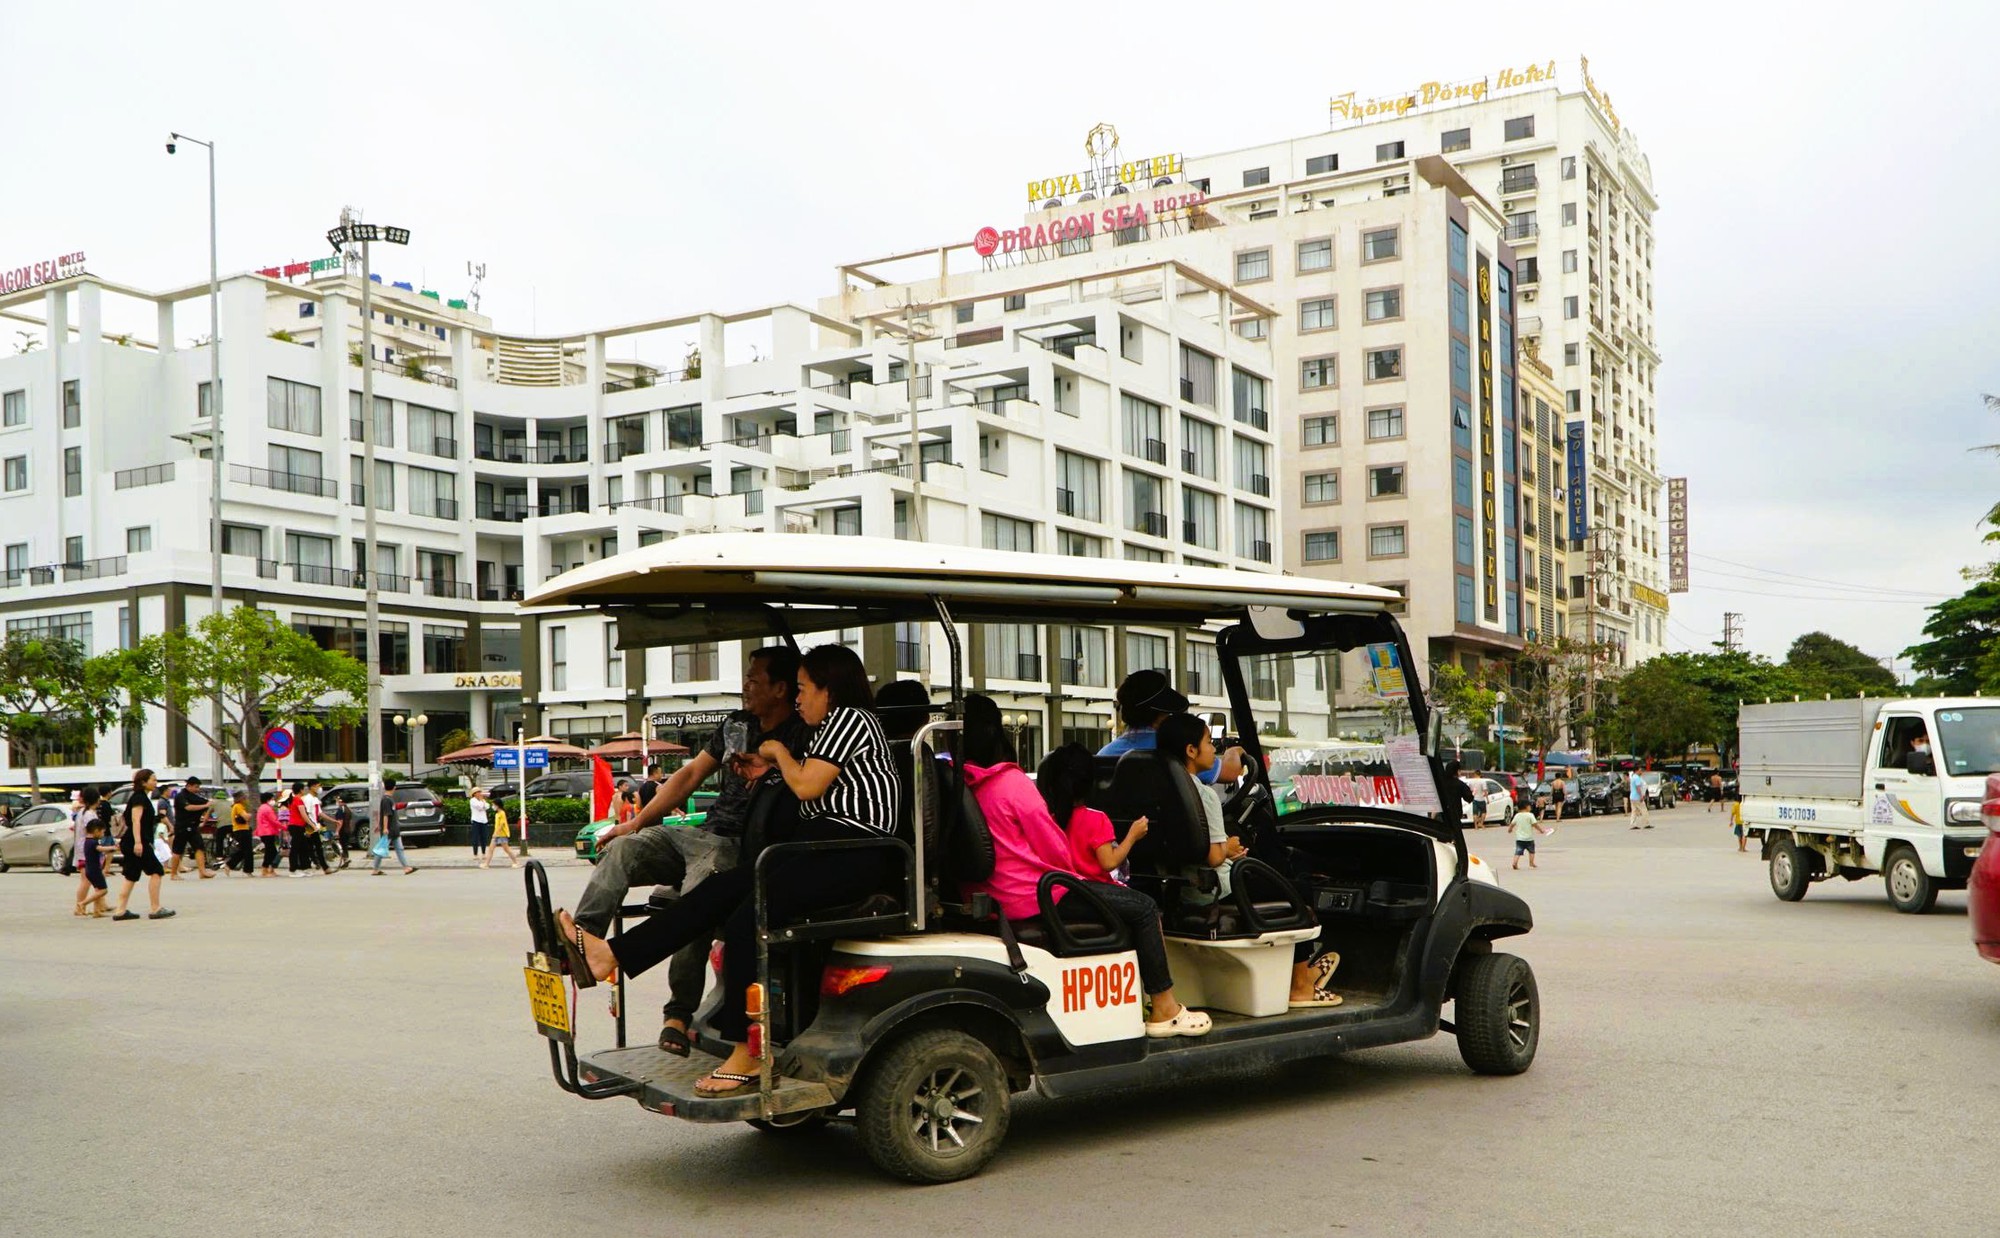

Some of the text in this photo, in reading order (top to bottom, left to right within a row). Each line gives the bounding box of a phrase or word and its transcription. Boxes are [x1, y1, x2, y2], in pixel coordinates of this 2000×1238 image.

[1496, 59, 1555, 89] Hotel
[1027, 153, 1183, 202] ROYAL HOTEL
[1002, 190, 1208, 253] DRAGON SEA HOTEL
[34, 259, 58, 283] SEA
[58, 251, 87, 267] HOTEL
[1481, 318, 1496, 606] ROYAL HOTEL
[1574, 488, 1582, 534] HOTEL
[455, 675, 522, 688] DRAGON
[651, 714, 684, 727] Galaxy
[1062, 961, 1137, 1013] HP092
